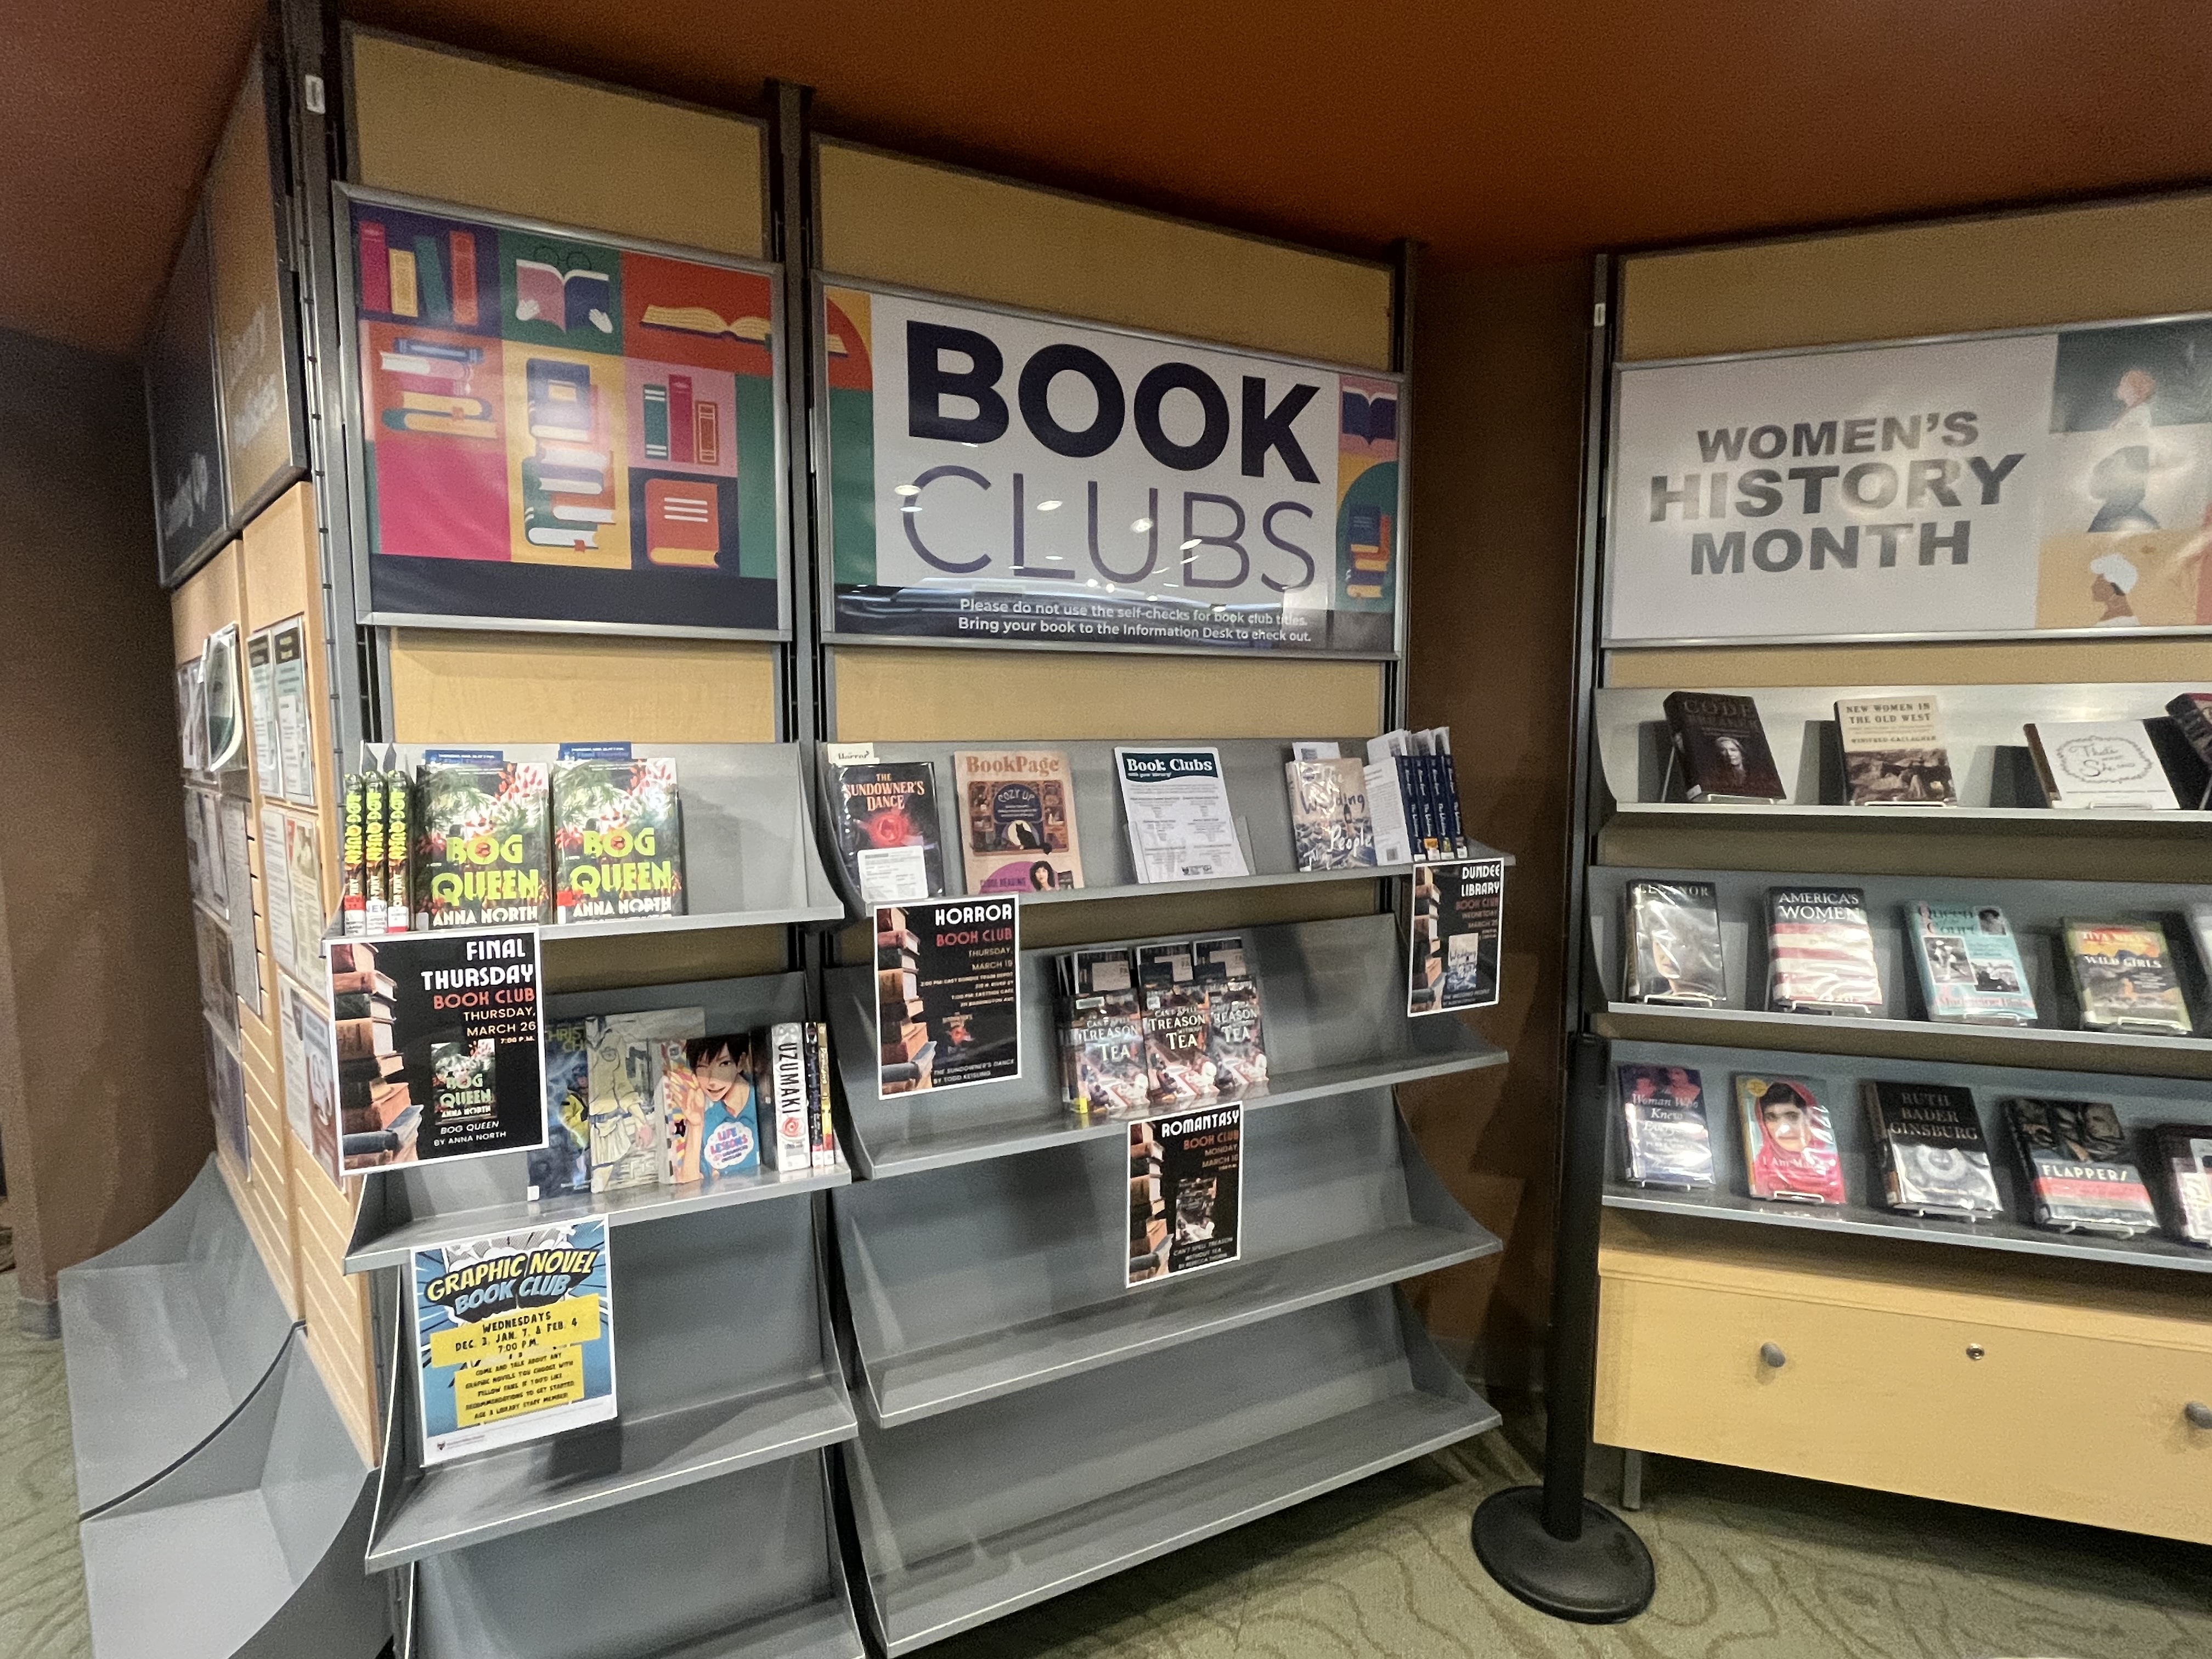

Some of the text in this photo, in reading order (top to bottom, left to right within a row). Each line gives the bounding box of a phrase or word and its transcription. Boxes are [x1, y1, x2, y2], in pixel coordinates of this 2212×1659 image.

[906, 320, 1321, 484] BOOK
[1697, 410, 1979, 463] WOMEN'S
[1649, 453, 2026, 522] HISTORY
[902, 464, 1316, 594] CLUBS
[1690, 520, 1971, 575] MONTH
[960, 598, 1008, 613] Please
[1013, 601, 1031, 613] do
[1035, 603, 1060, 615] not
[1063, 606, 1088, 617] use
[1091, 605, 1114, 618] the
[1118, 607, 1190, 621] self-checks
[1193, 609, 1211, 621] for
[1214, 611, 1244, 623] book
[1248, 612, 1273, 625] club
[958, 617, 1311, 642] Bring your book to the Information Desk to check out.
[1874, 703, 1913, 712] WOMEN
[1918, 702, 1930, 710] IN
[1849, 713, 1930, 724] THE OLD WEST
[966, 755, 1059, 777] BookPage
[1126, 758, 1213, 771] Book Clubs
[876, 773, 892, 782] THE
[842, 781, 925, 799] SUNDOWNER'S
[997, 789, 1020, 803] COZY
[866, 794, 905, 811] DANCE
[583, 827, 656, 857] BOG
[1328, 823, 1374, 857] People
[447, 834, 523, 865] BOG
[570, 861, 672, 898] QUEEN
[1462, 864, 1500, 879] DUNDEE
[432, 869, 539, 906] QUEEN
[1461, 881, 1500, 897] LIBRARY
[573, 896, 672, 917] ANNA NORTH
[1779, 893, 1859, 904] AMERICA'S
[433, 906, 538, 927] ANNA NORTH
[935, 904, 1012, 926] HORROR
[1778, 906, 1865, 923] WOMEN
[936, 927, 1012, 947] BOOK CLUB
[466, 939, 526, 961] FINAL
[972, 961, 1002, 970] MARCH
[2084, 955, 2162, 968] WILD GIRLS
[420, 964, 533, 990] THURSDAY
[433, 988, 535, 1009] BOOK CLUB
[464, 1006, 535, 1021] THURSDAY,
[467, 1021, 537, 1036] MARCH 26
[1149, 1014, 1206, 1031] TREASON
[1081, 1025, 1138, 1041] TREASON
[1166, 1031, 1198, 1050] TEA
[1221, 1025, 1251, 1042] TEA
[1098, 1043, 1131, 1062] TEA
[446, 1073, 483, 1090] BOG
[778, 1043, 801, 1113] UZUMAKI
[440, 1088, 492, 1108] QUEEN
[1632, 1093, 1699, 1109] Woman Who
[1901, 1092, 1950, 1107] RUTH
[1651, 1108, 1684, 1120] Knew
[1901, 1107, 1959, 1123] BADER
[466, 1120, 499, 1132] QUEEN
[1161, 1109, 1239, 1138] ROMANTASY
[1889, 1122, 1978, 1139] GINSBURG
[448, 1135, 473, 1144] ANNA
[476, 1131, 506, 1141] NORTH
[718, 1127, 737, 1141] LIFE
[1217, 1130, 1240, 1142] CLUB
[1202, 1155, 1230, 1168] MARCH
[2042, 1164, 2128, 1182] FLAPPERS
[427, 1250, 599, 1302] GRAPHIC NOVEL
[455, 1273, 571, 1315] BOOK CLUB
[483, 1311, 551, 1334] WEDNESDAYS
[572, 1318, 577, 1327] 4
[498, 1342, 517, 1353] 7:00
